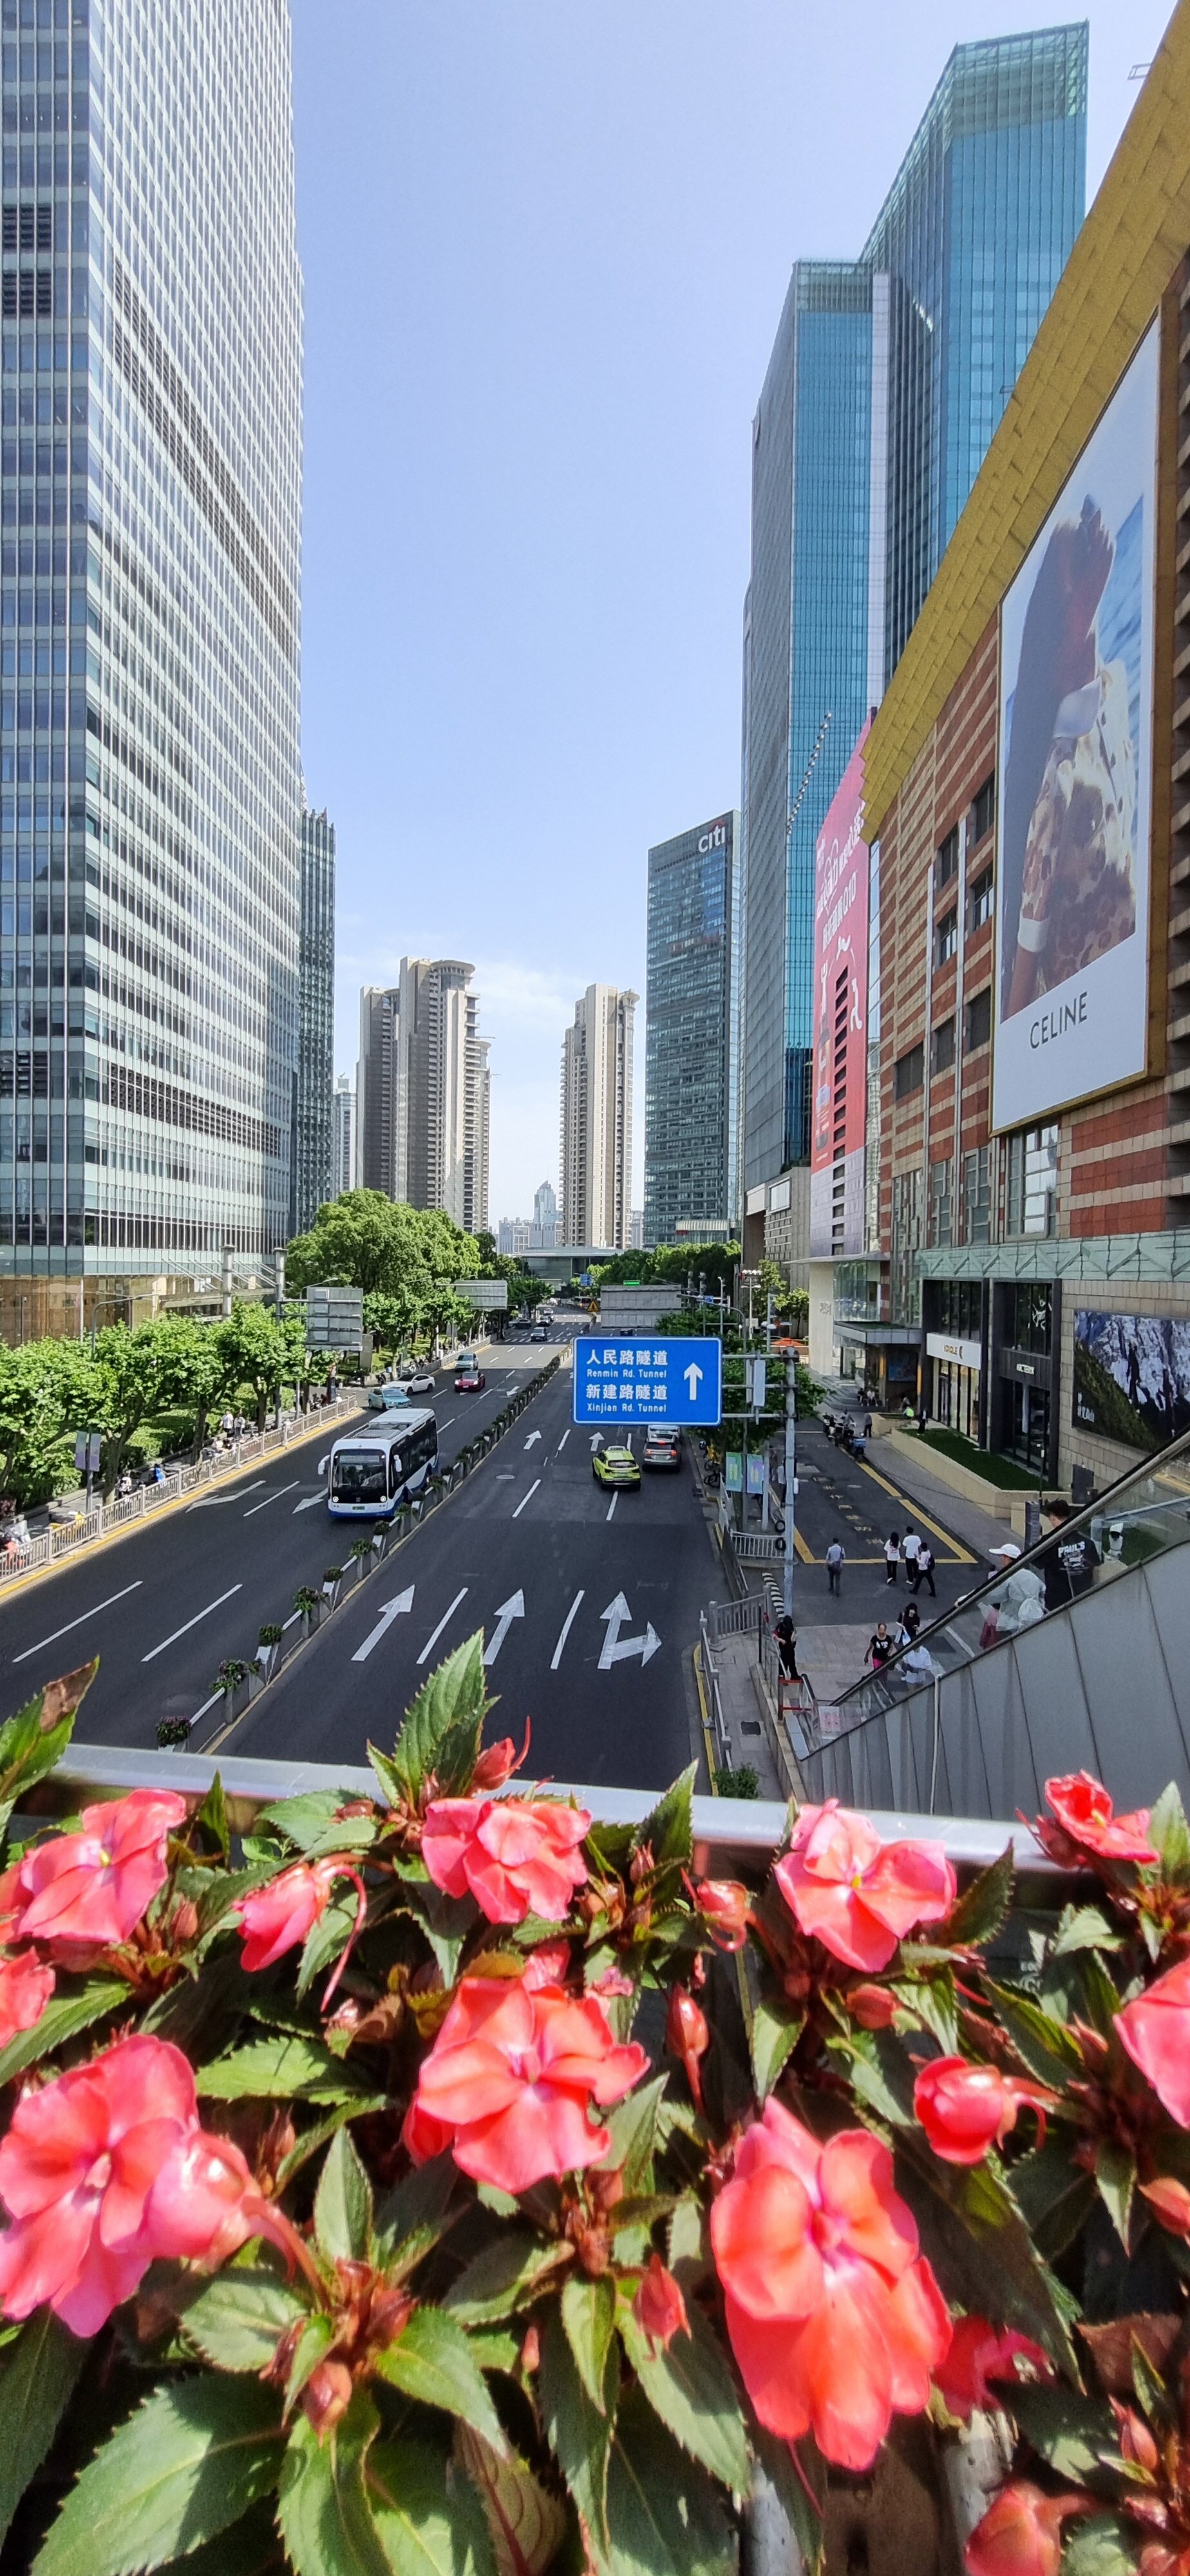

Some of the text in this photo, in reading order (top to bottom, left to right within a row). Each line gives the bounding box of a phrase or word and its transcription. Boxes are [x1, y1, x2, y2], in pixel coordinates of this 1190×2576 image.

[698, 825, 725, 853] citi
[1030, 992, 1087, 1049] CELINE
[587, 1349, 668, 1365] 人民路隧道
[587, 1368, 667, 1378] Renmin Rd. Tunnel
[586, 1384, 667, 1399] 新建路隧道
[587, 1403, 666, 1414] Xinjian Rd. Tunnel
